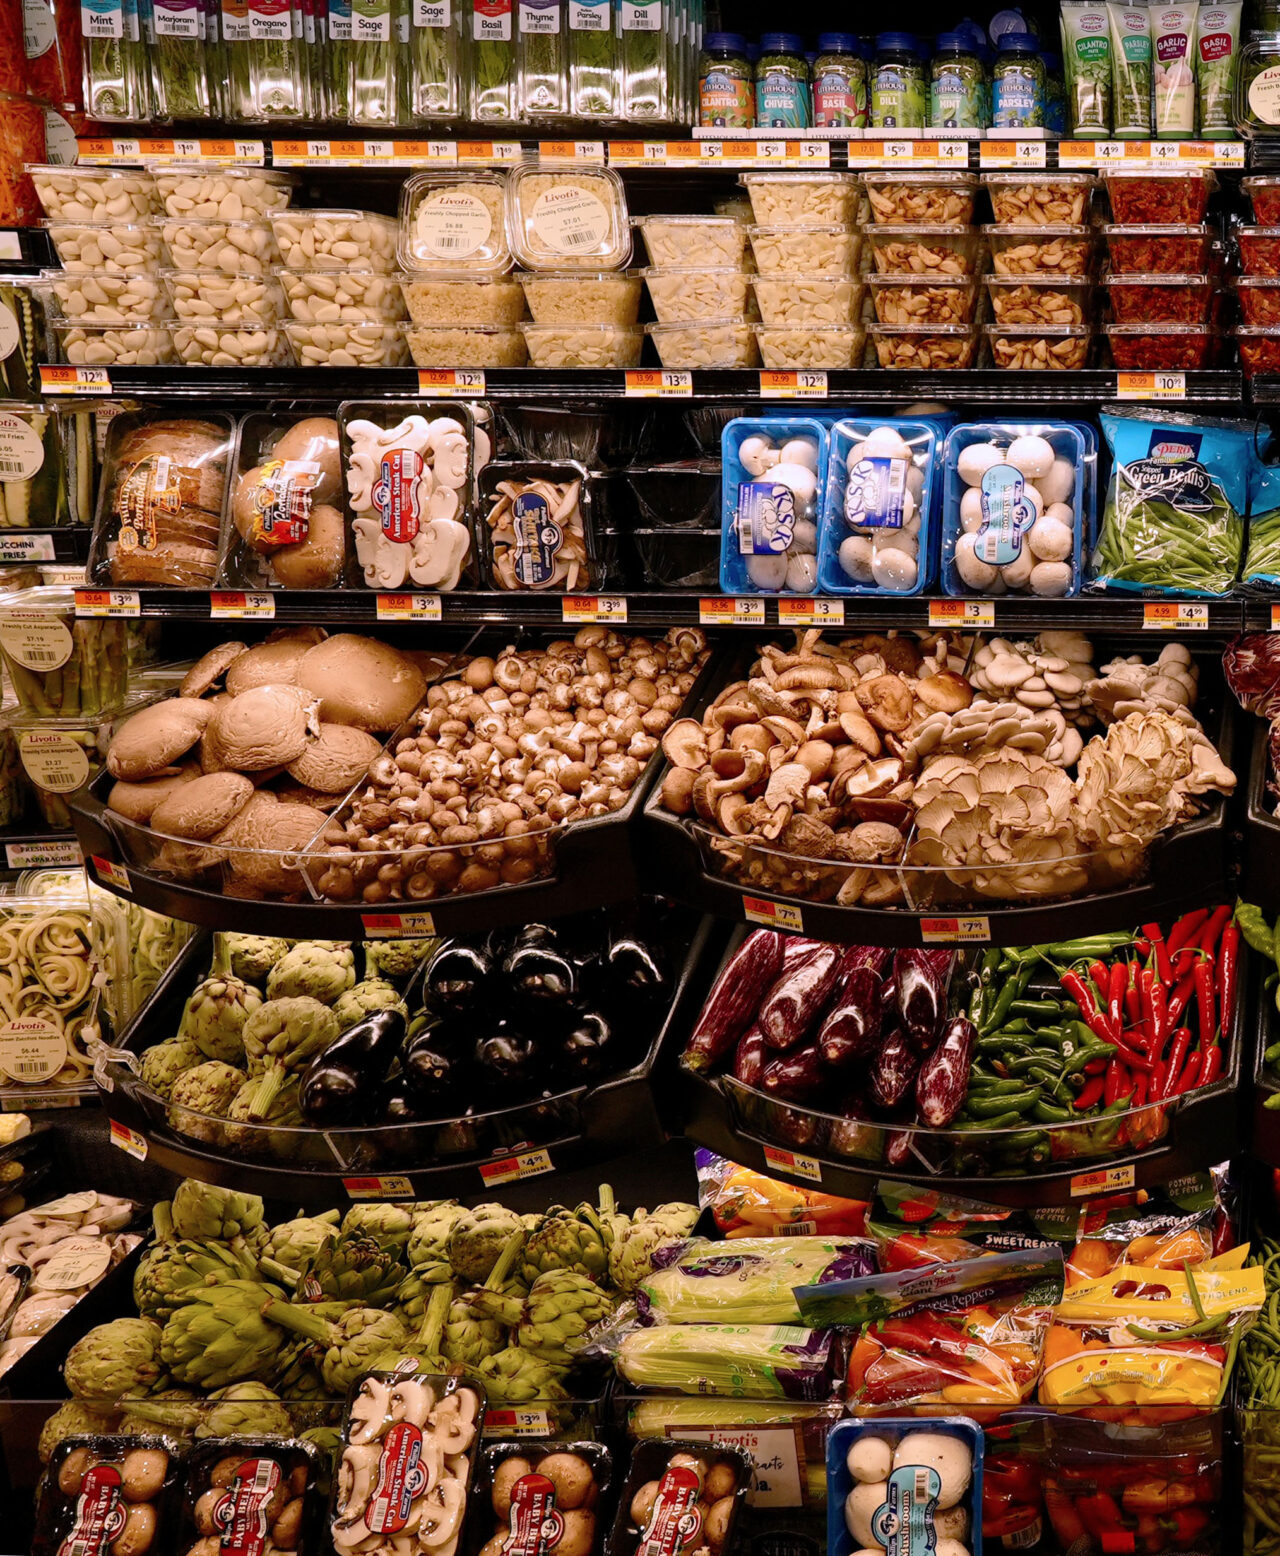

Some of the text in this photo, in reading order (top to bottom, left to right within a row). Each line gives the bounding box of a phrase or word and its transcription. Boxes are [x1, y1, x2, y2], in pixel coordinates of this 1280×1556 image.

[421, 6, 444, 18] Sage
[576, 10, 602, 20] Parsley
[634, 9, 648, 19] Dill
[90, 15, 113, 26] Mint
[157, 15, 195, 26] Marjoram
[252, 18, 287, 29] Oregano
[526, 12, 554, 24] Thyme
[358, 19, 382, 32] Sage
[482, 19, 502, 30] Basil
[1077, 40, 1108, 51] CILANTRO
[1125, 41, 1149, 50] PARSLEY
[1158, 38, 1186, 50] GARLIC
[1203, 38, 1227, 50] BASIL
[702, 98, 738, 108] CILANTRO
[764, 98, 794, 109] CHIVES
[822, 98, 847, 108] BASIL
[880, 96, 897, 106] DILL
[940, 99, 960, 109] MINT
[998, 98, 1034, 109] PARSLEY
[536, 210, 556, 218] Freshly
[1129, 468, 1168, 485] Green
[1000, 483, 1010, 544] Mushrooms
[3, 551, 27, 560] FRIES
[2, 624, 22, 632] Freshly
[54, 844, 72, 852] CUT
[952, 1286, 995, 1308] Peppers
[396, 1427, 411, 1474] American
[233, 1478, 254, 1548] BABY BELLA
